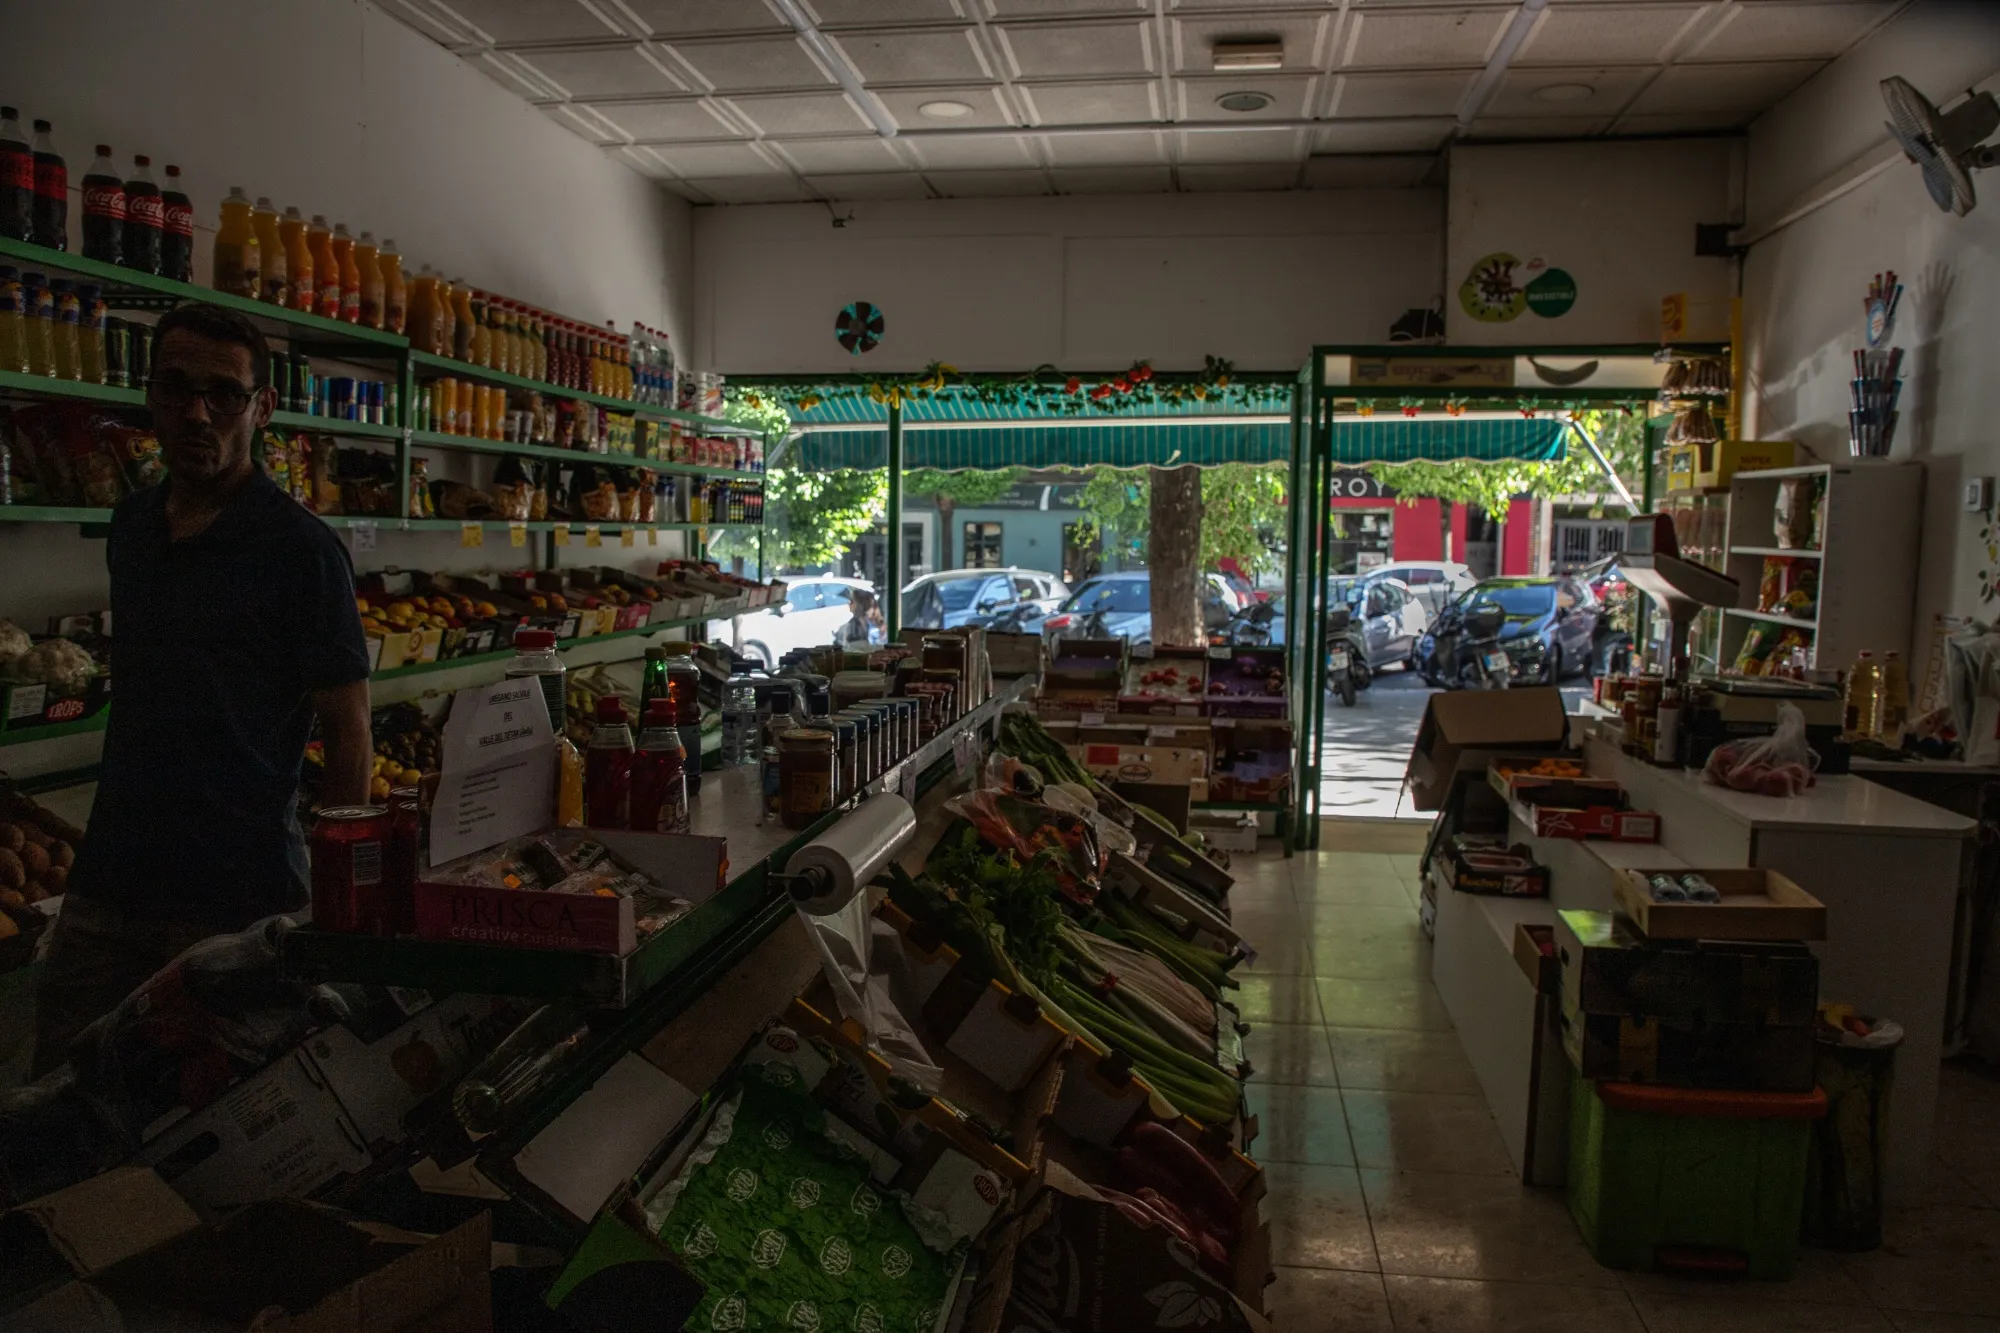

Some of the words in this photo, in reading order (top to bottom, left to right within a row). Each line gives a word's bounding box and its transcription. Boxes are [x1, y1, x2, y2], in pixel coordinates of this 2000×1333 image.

[47, 700, 85, 719] TROPS
[450, 894, 580, 932] PRISCA
[451, 924, 520, 943] creative
[522, 931, 581, 948] cuisine
